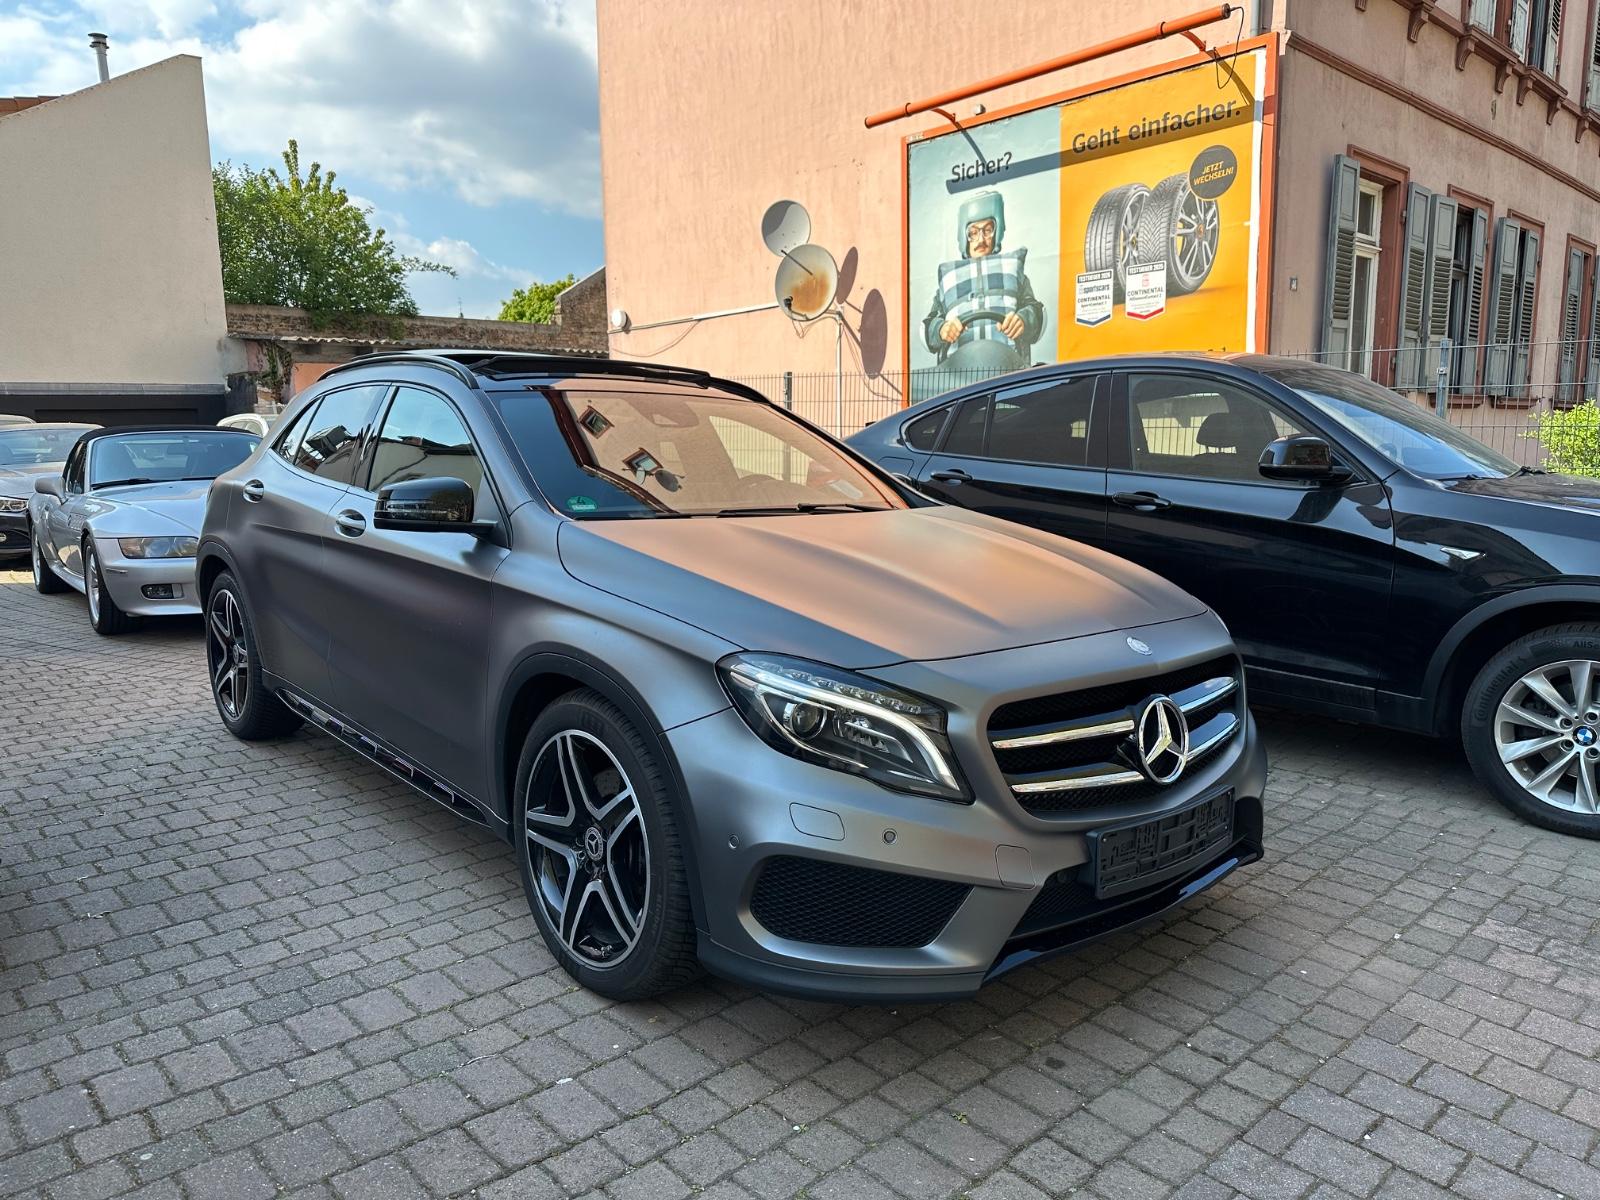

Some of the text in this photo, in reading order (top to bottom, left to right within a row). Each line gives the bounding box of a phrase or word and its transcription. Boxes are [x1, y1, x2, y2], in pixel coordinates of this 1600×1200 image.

[1072, 100, 1241, 154] Geht einfacher.
[951, 152, 1012, 184] Sicher?
[1193, 166, 1234, 185] WECHSELN!
[1202, 160, 1224, 174] JETZT
[1078, 294, 1111, 303] CONTINENTAL
[1127, 286, 1164, 296] CONTINENTAL
[1473, 660, 1520, 721] Continental
